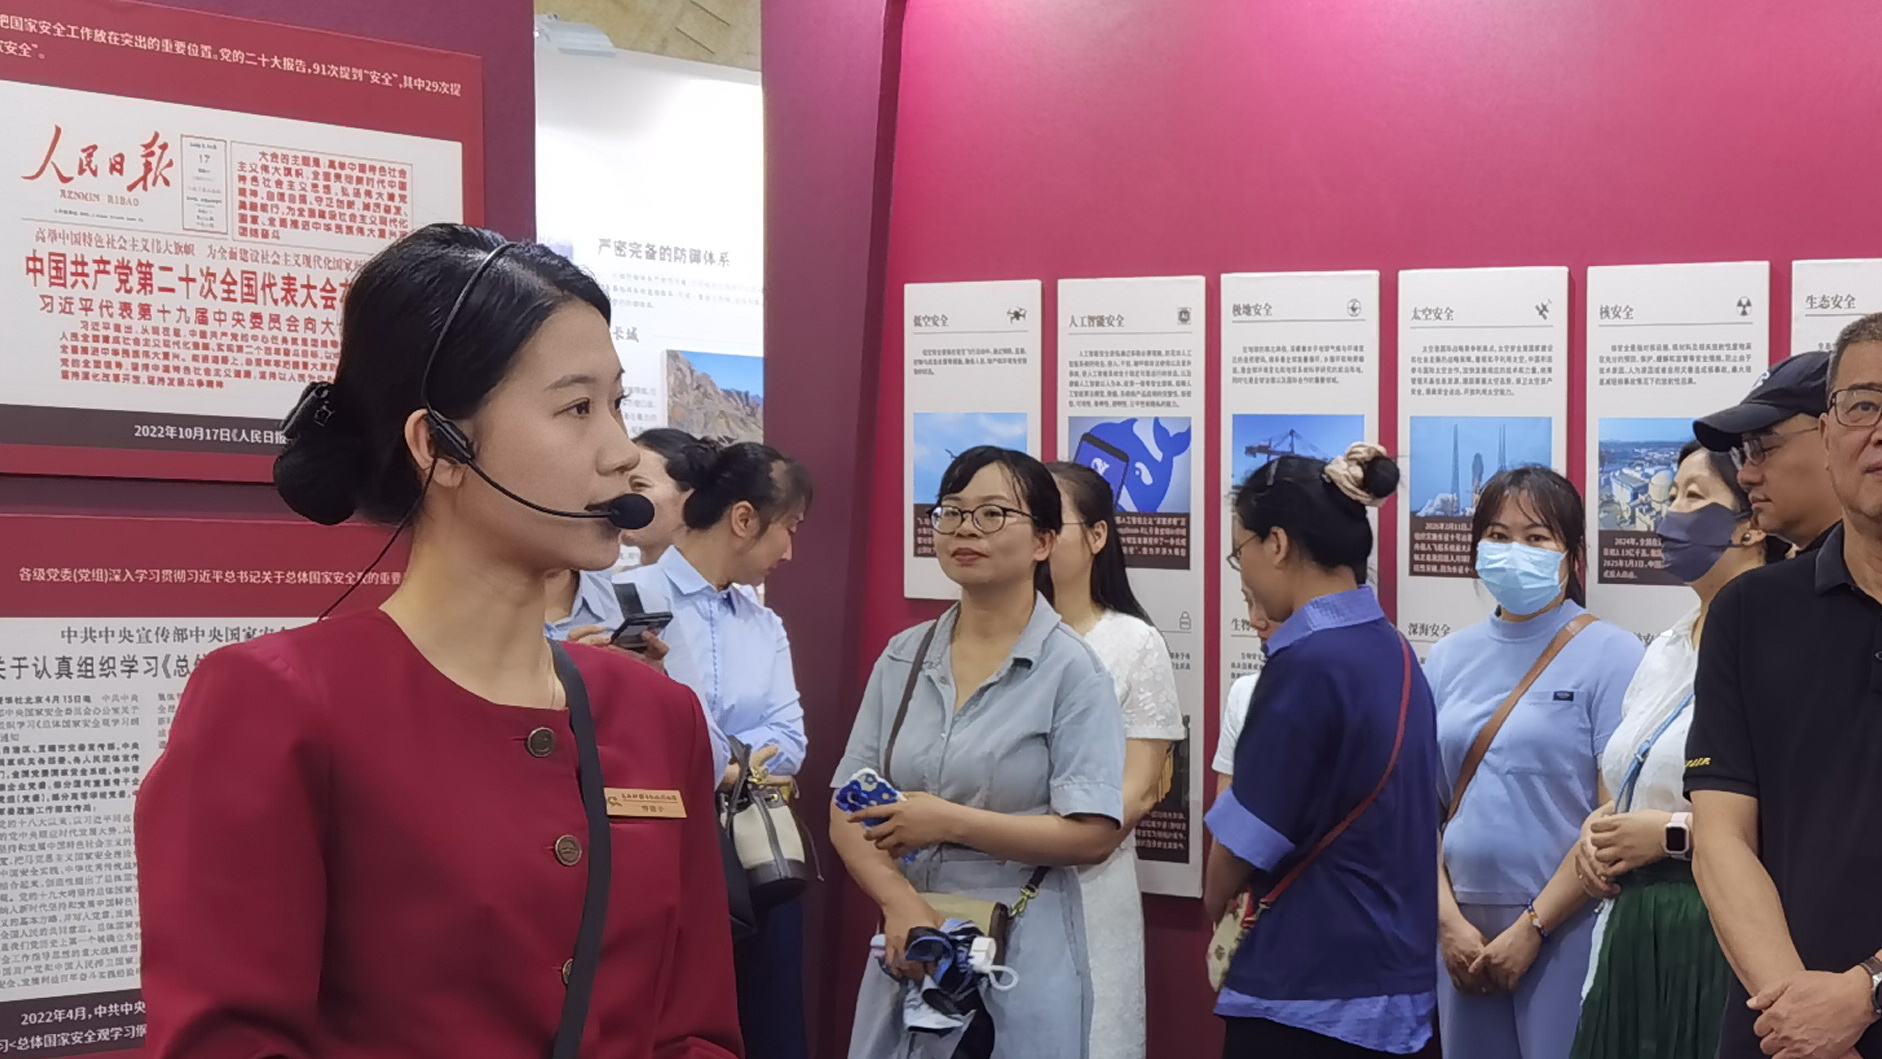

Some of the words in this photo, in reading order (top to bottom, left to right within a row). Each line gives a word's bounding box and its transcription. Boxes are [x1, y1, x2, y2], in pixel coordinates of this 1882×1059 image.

[59, 188, 101, 202] RENMIN
[106, 193, 140, 207] RIBAO
[1232, 302, 1273, 317] 极地安全
[1804, 293, 1856, 310] 生态安全
[912, 313, 949, 328] 低空安全
[1410, 306, 1455, 321] 太空安全
[1599, 304, 1635, 321] 核安全
[1068, 313, 1125, 329] 人工智能安全
